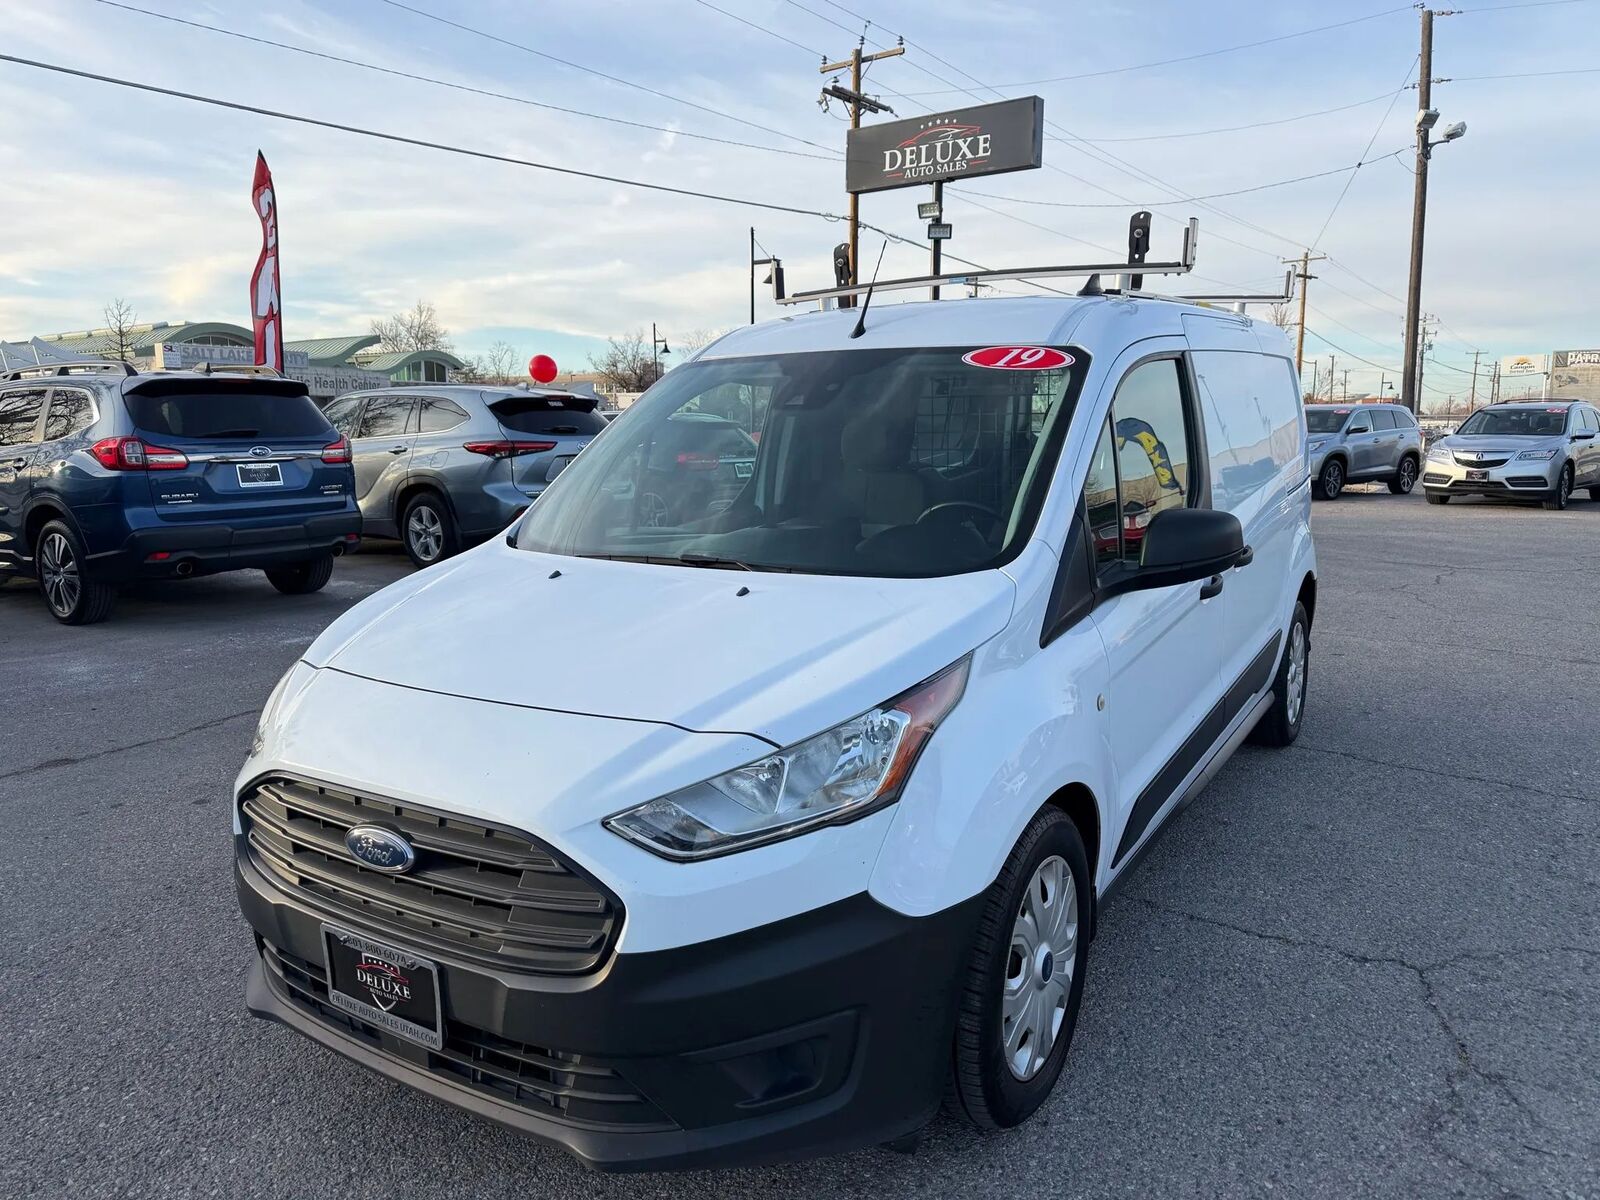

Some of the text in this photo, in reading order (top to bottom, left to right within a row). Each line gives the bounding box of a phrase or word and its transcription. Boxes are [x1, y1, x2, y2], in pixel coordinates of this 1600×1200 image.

[883, 134, 991, 172] DELUXE
[904, 160, 967, 179] AUTO SALES
[182, 346, 214, 361] SALT
[219, 348, 253, 362] LAKE
[989, 348, 1046, 367] 19
[1567, 352, 1600, 366] PATR
[314, 376, 348, 390] Health
[351, 378, 381, 391] Center
[357, 834, 394, 864] Ford
[356, 968, 412, 999] DELUXE
[369, 987, 399, 1001] AUTO SALES
[332, 993, 438, 1046] DELUXE AUTO SALES UTAH.COM
